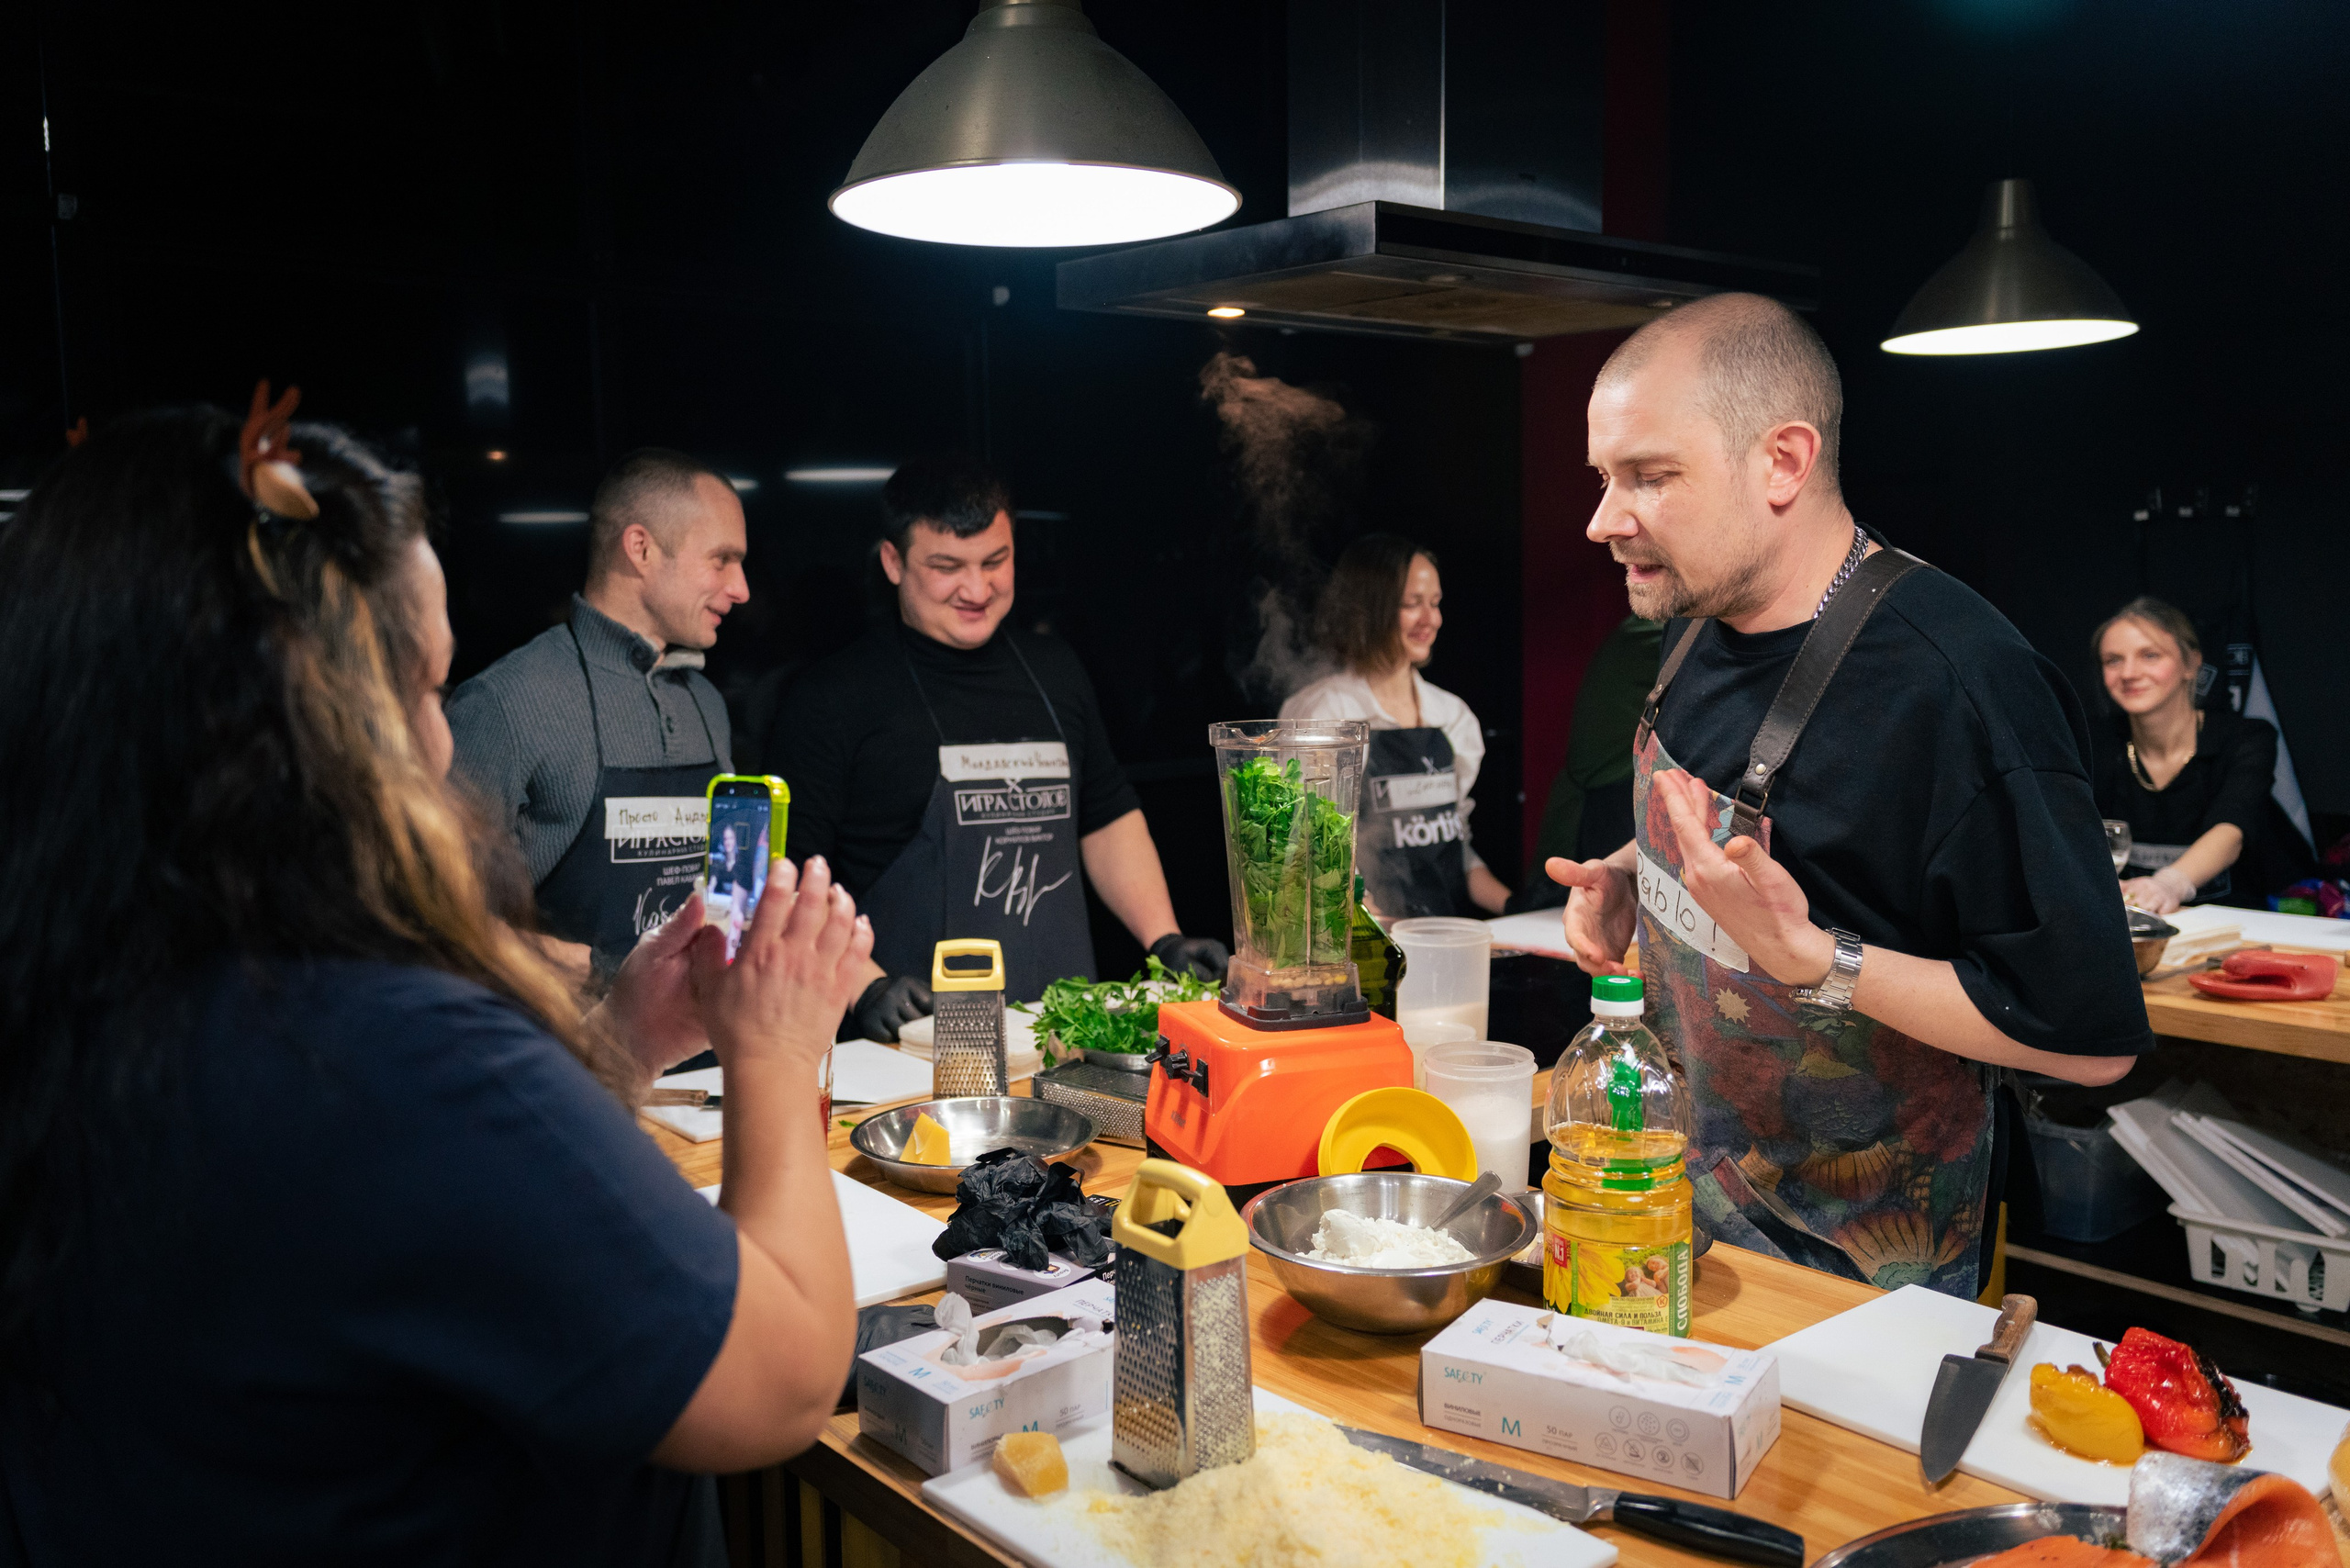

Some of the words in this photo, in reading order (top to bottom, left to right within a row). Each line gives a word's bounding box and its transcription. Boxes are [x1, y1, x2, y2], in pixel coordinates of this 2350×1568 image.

[619, 808, 658, 828] Просто
[965, 1275, 991, 1288] Перчатки
[991, 1282, 1024, 1295] виниловые
[965, 1283, 986, 1294] чёрные
[1676, 1249, 1688, 1331] СЛОБОДА
[1584, 1308, 1613, 1318] ДВОЙНАЯ
[1639, 1310, 1662, 1319] ПОЛЬЗА
[1631, 1316, 1663, 1326] ВИТАМИНА
[1059, 1406, 1069, 1417] 50
[1501, 1417, 1521, 1438] M
[1546, 1425, 1557, 1435] 50
